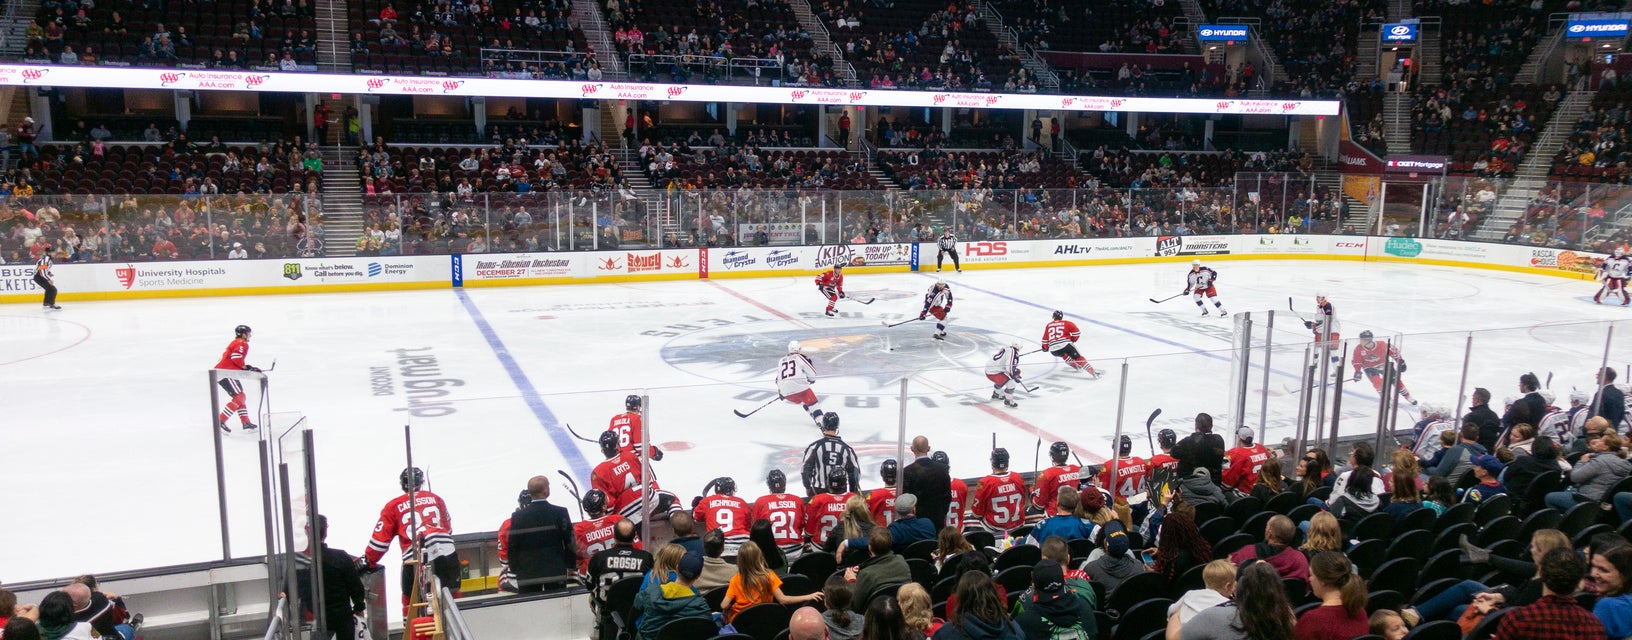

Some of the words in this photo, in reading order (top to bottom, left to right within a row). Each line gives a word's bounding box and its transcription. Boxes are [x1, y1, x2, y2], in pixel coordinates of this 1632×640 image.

[1586, 23, 1628, 32] HYUNDAI
[189, 72, 204, 80] Auto
[206, 73, 243, 81] Insurance
[198, 81, 235, 89] AAA.com
[1414, 161, 1444, 169] Mortgage
[965, 241, 1007, 257] HDS
[1160, 237, 1179, 250] ALT
[1388, 240, 1419, 250] Hudec
[823, 245, 846, 259] KID
[865, 246, 881, 254] SIGN
[1164, 247, 1176, 256] 99.1
[1532, 250, 1556, 258] RASCAL
[723, 253, 749, 264] Diamond
[734, 258, 756, 268] Crystal
[766, 252, 792, 263] Diamond
[777, 257, 799, 267] Crystal
[821, 254, 850, 267] NATION
[1539, 258, 1556, 266] HOUSE
[284, 263, 300, 275] 811
[476, 260, 531, 270] Trans-Siberian
[532, 259, 570, 268] Orchestra
[117, 269, 127, 277] UH
[138, 269, 184, 280] University
[185, 267, 226, 278] Hospitals
[139, 279, 165, 287] Sports
[167, 277, 204, 285] Medicine
[1048, 326, 1065, 340] 25
[781, 359, 796, 380] 23
[829, 452, 838, 465] 5
[613, 461, 631, 476] KRYS
[1118, 463, 1146, 477] ENTWISTLE
[1058, 473, 1080, 484] JOHNSO
[998, 483, 1016, 494] WEDIN
[1120, 474, 1148, 496] 44
[709, 499, 741, 509] HIGHMORE
[768, 501, 796, 511] NILSSON
[991, 493, 1022, 523] 57
[716, 508, 734, 533] 9
[769, 511, 799, 539] 21
[607, 556, 643, 570] CROSBY
